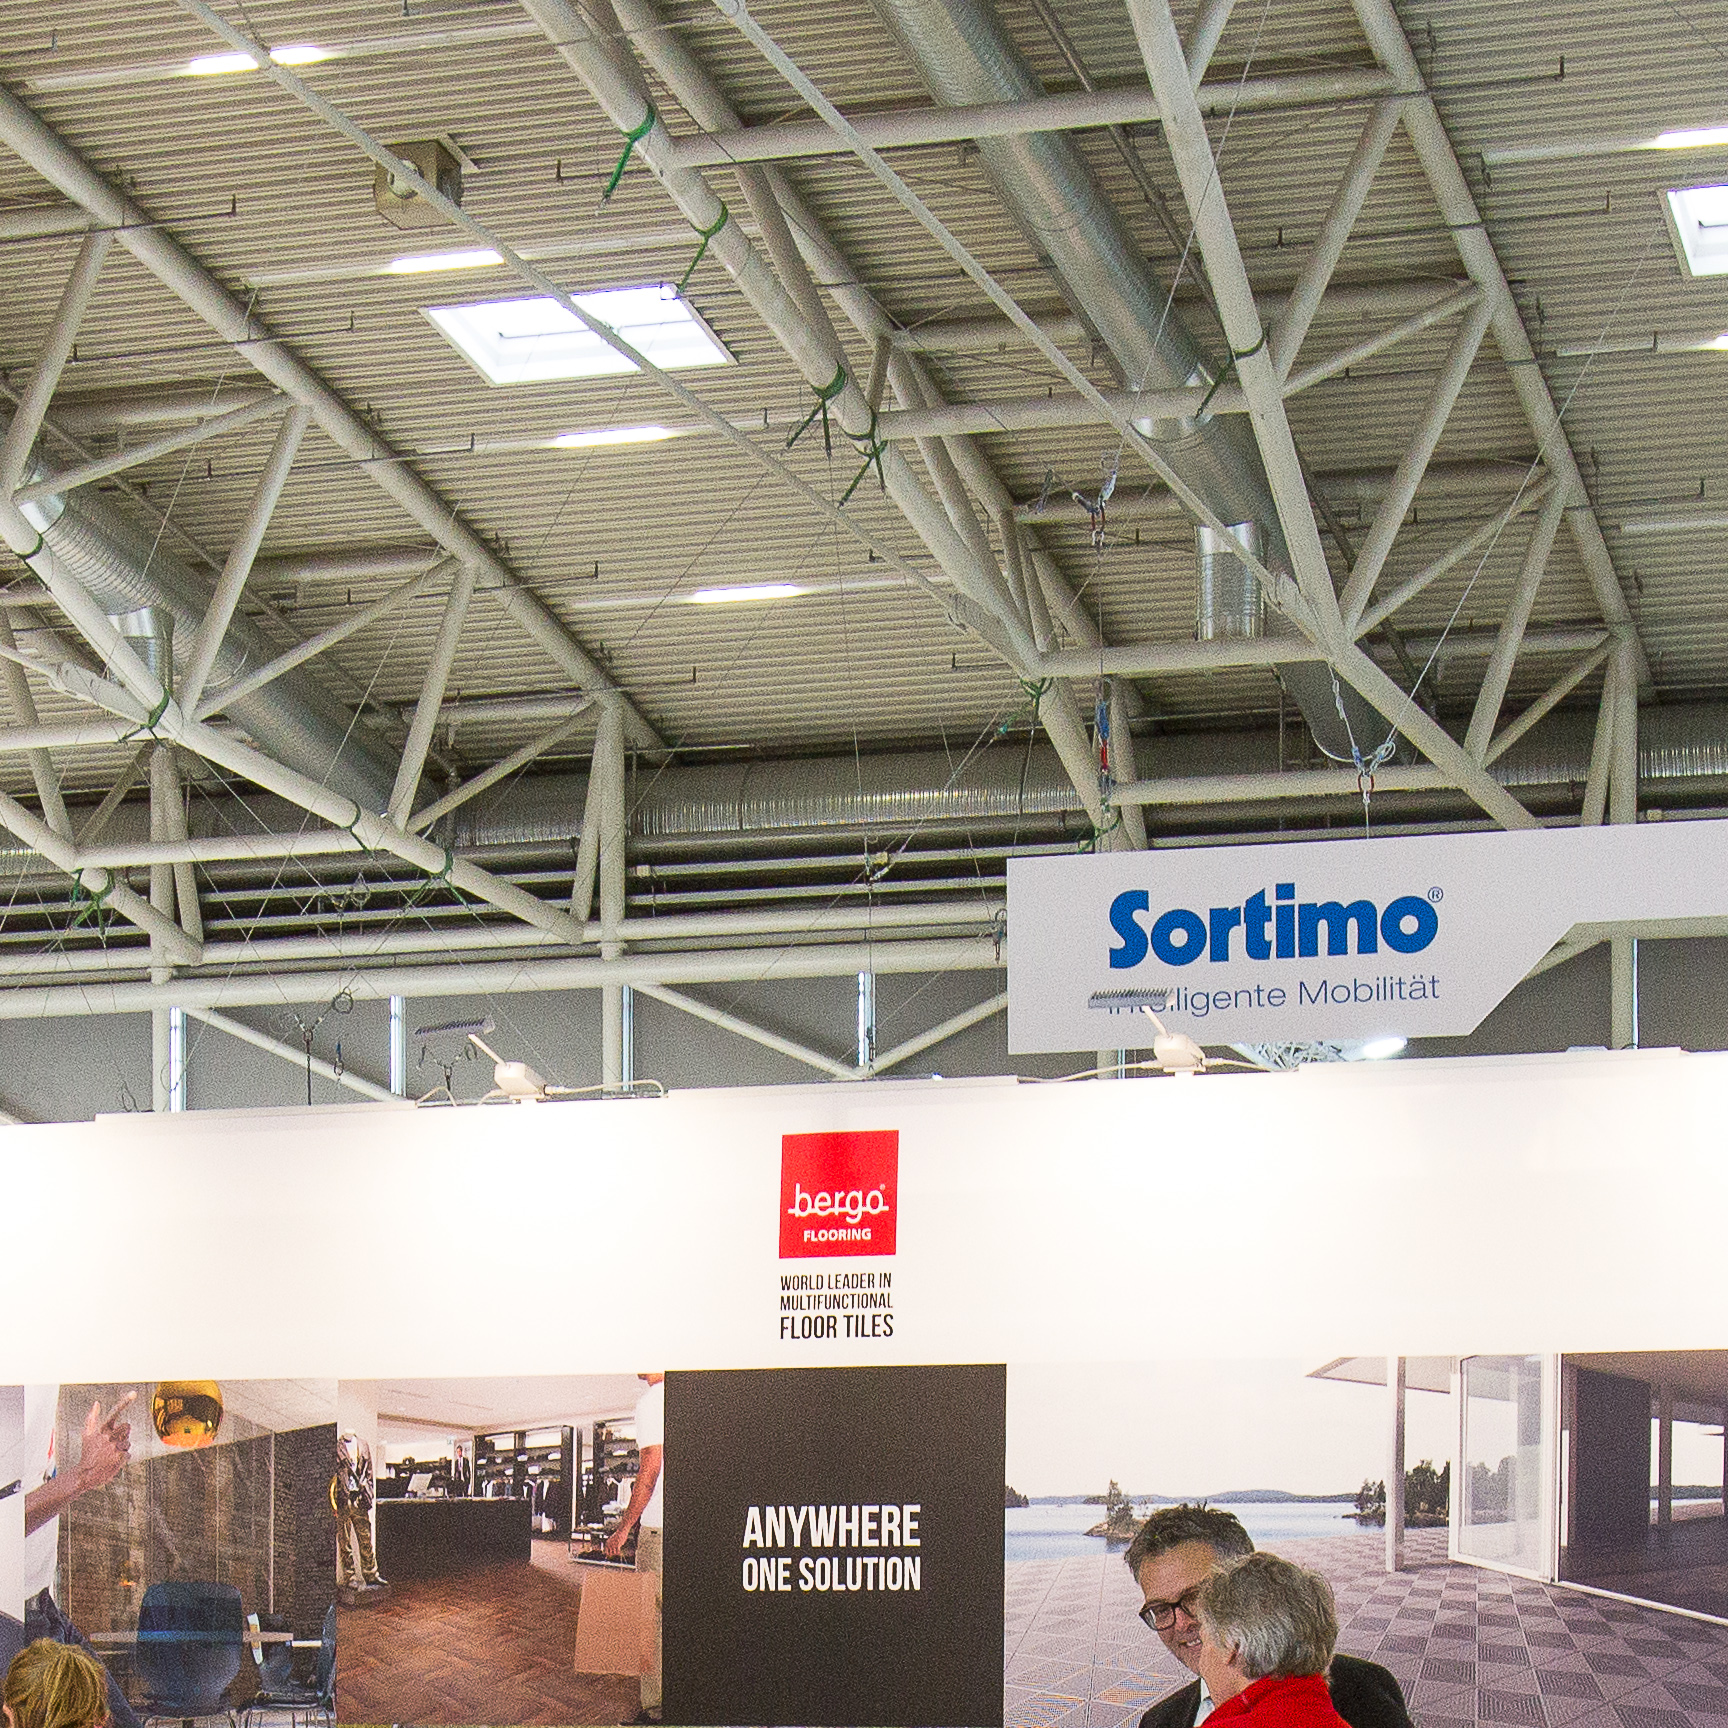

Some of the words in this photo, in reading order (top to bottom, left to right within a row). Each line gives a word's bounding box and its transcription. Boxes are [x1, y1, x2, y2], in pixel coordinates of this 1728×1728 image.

[1298, 975, 1440, 1004] Mobilität
[788, 1183, 889, 1224] bergo
[804, 1228, 872, 1242] FLOORING
[780, 1274, 823, 1291] WORLD
[828, 1273, 875, 1290] LEADER
[879, 1272, 892, 1288] IN
[780, 1293, 893, 1311] MULTIFUNCTIONAL
[780, 1315, 837, 1339] FLOOR
[843, 1313, 894, 1338] TILES
[743, 1504, 921, 1548] ANYWHERE
[742, 1556, 792, 1592] ONE
[798, 1555, 921, 1592] SOLUTION
